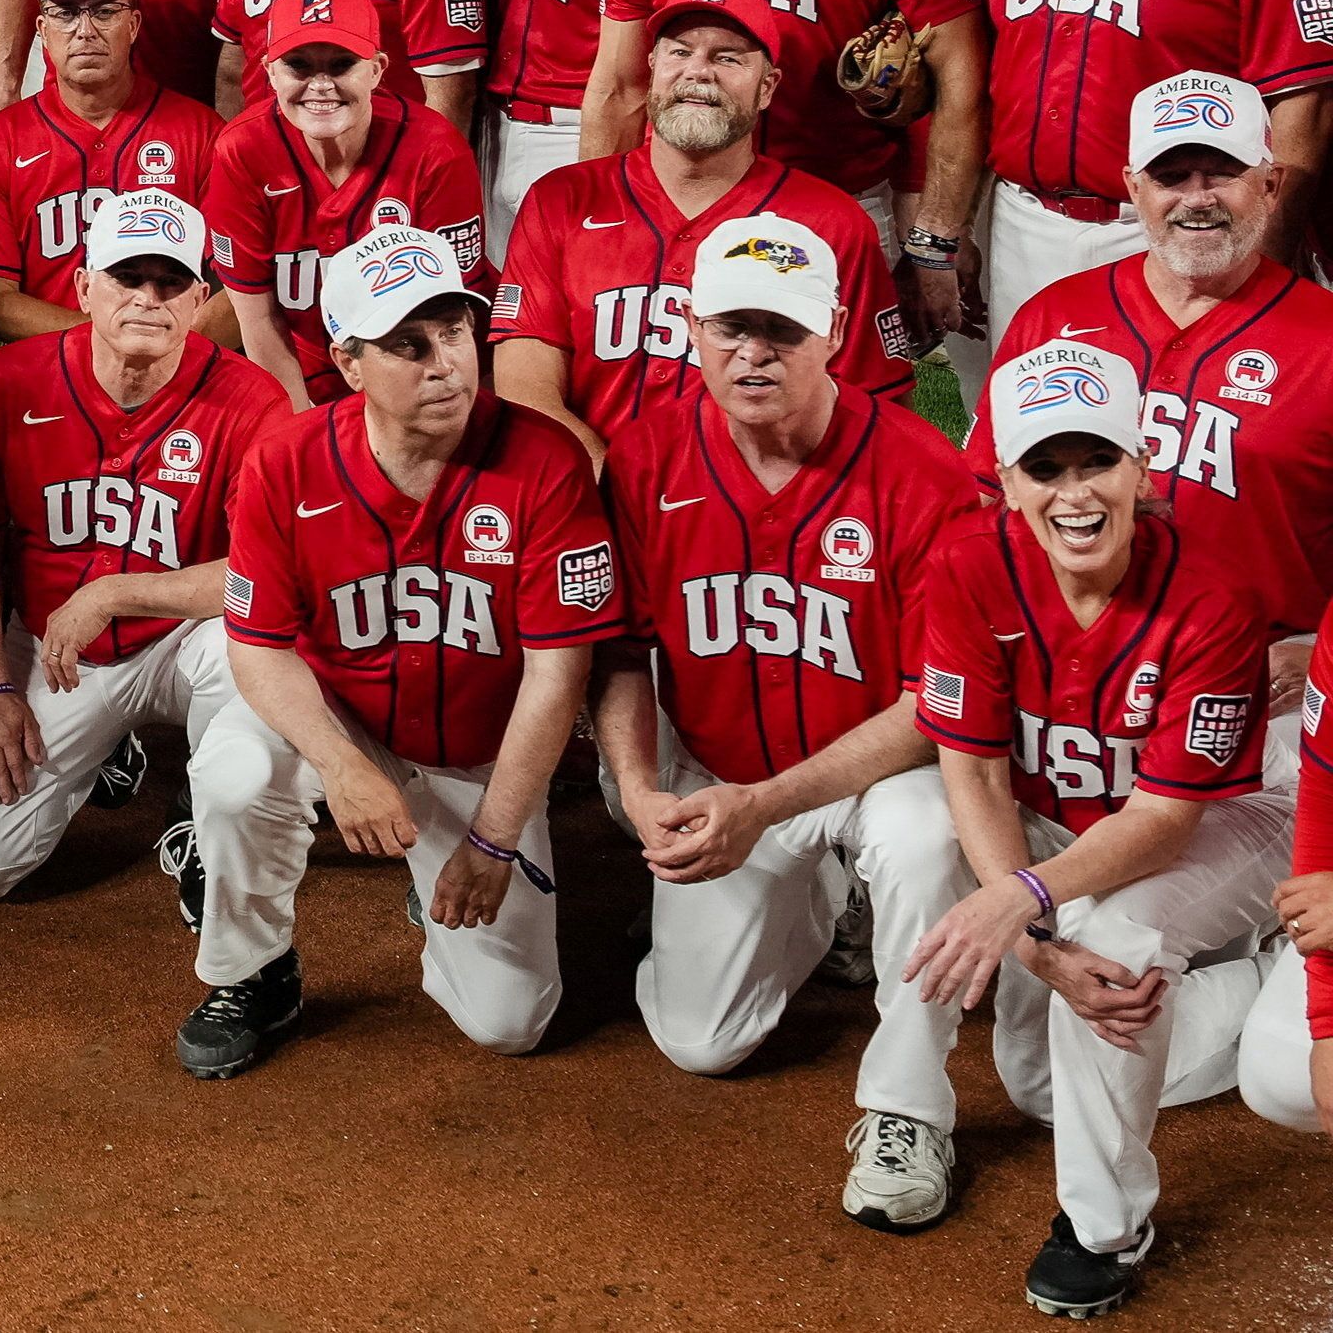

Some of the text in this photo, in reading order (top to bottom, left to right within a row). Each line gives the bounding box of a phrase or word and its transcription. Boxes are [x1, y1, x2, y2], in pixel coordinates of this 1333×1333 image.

[1154, 77, 1233, 100] AMERICA
[1153, 91, 1235, 134] 250
[118, 193, 188, 218] AMERICA
[116, 208, 188, 245] 250
[354, 227, 433, 265] AMERICA
[360, 242, 445, 299] 250
[1016, 348, 1104, 377] AMERICA
[1016, 366, 1110, 416] 250
[1222, 388, 1269, 405] 6-14-17
[159, 469, 200, 484] 6-14-17
[42, 475, 183, 571] USA
[466, 550, 513, 565] 6-14-17
[564, 550, 609, 575] USA
[822, 567, 874, 582] 6-14-17
[563, 575, 614, 603] 250
[331, 565, 503, 658] USA
[682, 571, 863, 683] USA
[1201, 701, 1248, 722] USA
[1193, 726, 1246, 752] 250
